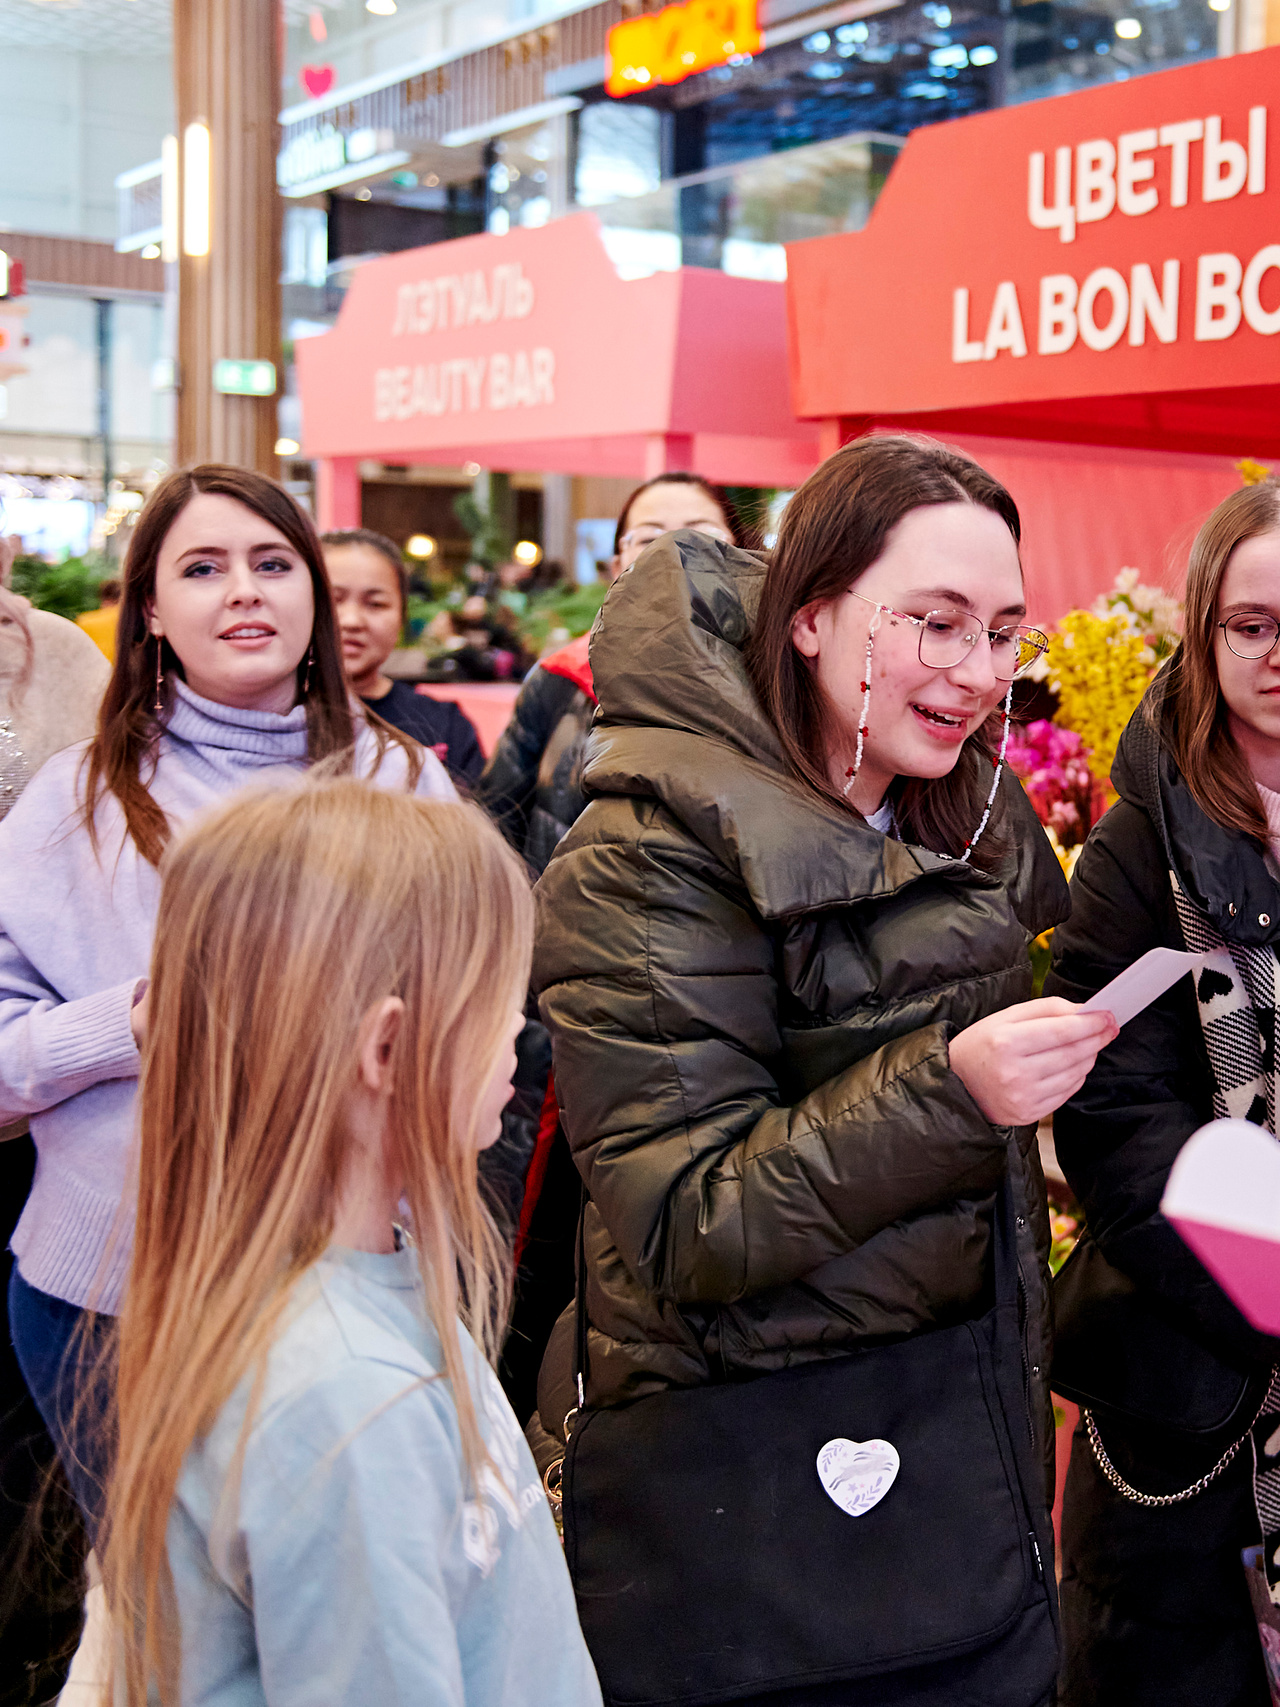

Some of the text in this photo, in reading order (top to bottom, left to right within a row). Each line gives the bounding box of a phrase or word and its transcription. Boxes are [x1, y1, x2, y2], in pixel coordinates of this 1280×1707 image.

[1027, 105, 1267, 243] ЦВЕТЫ
[392, 262, 534, 338] ЛЭТУАЛЬ
[952, 281, 1028, 364] LA
[1038, 258, 1180, 356] BON
[374, 347, 556, 422] BEAUTY BAR
